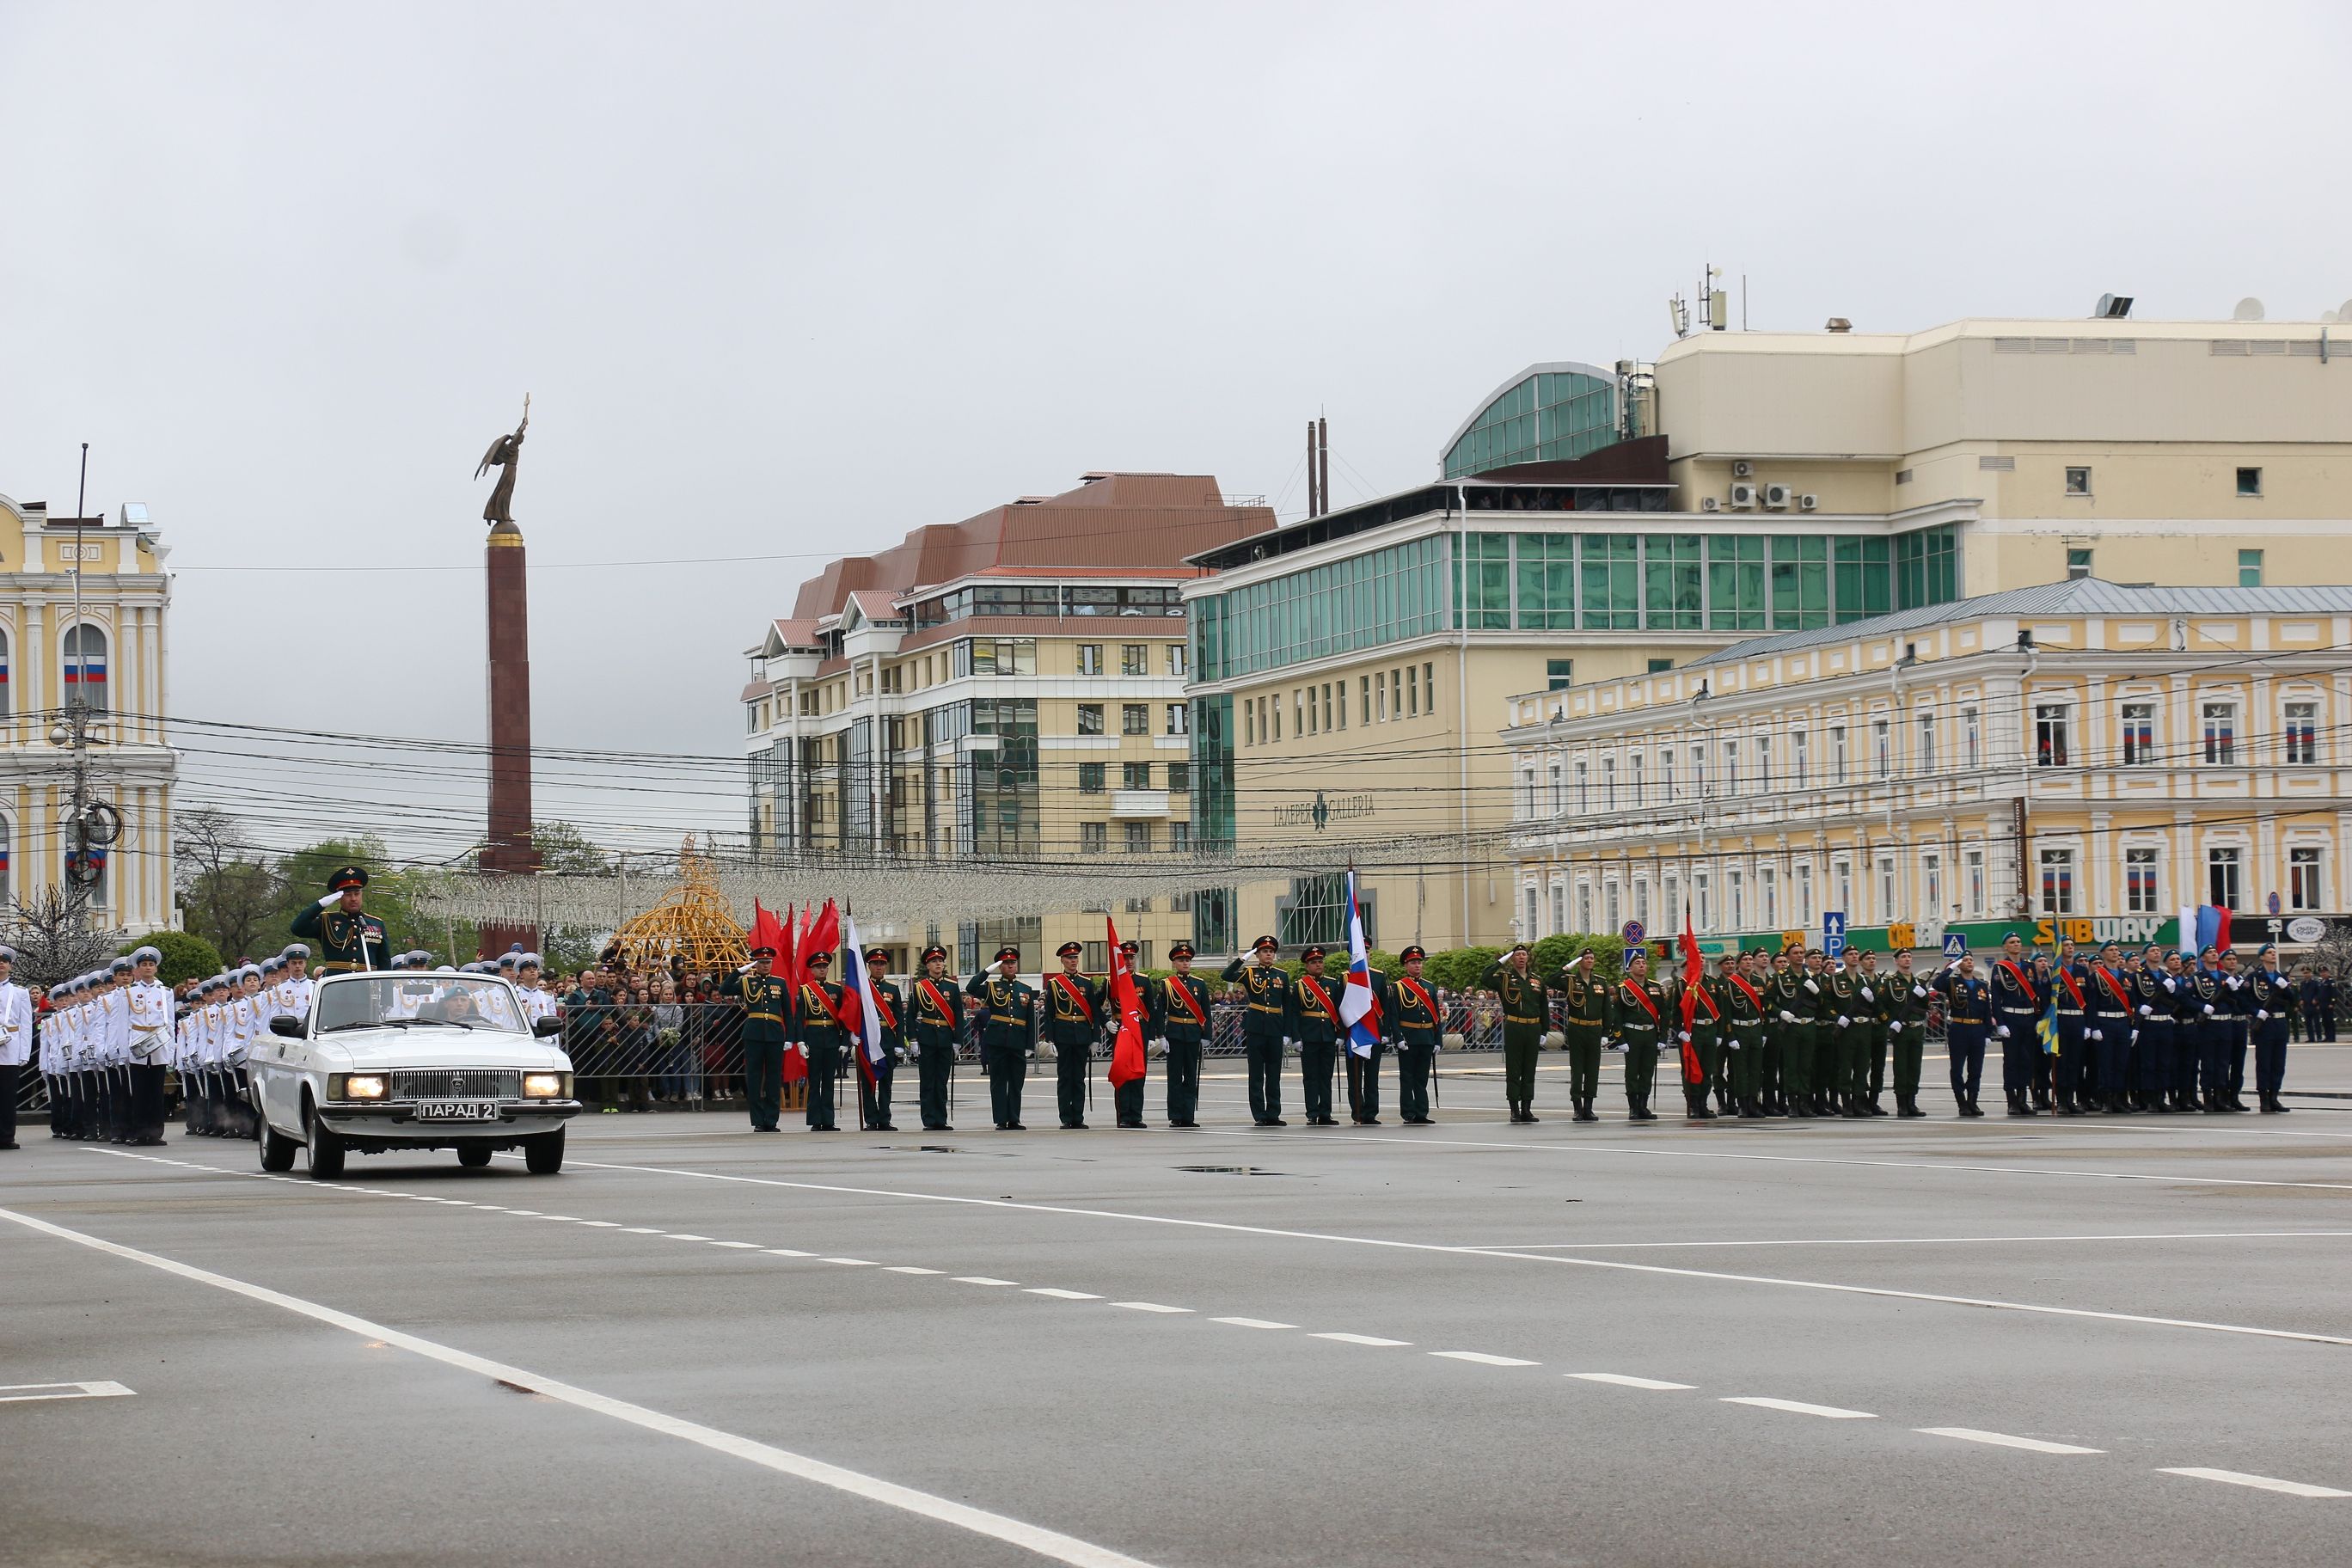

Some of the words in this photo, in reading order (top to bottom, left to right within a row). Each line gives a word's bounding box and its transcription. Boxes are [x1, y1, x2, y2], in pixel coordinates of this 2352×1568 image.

[1274, 803, 1311, 827] ГАЛЕРЕЯ
[1328, 793, 1375, 821] GALLERIA
[2032, 916, 2167, 945] SUBWAY
[1829, 938, 1841, 956] P
[422, 1104, 477, 1118] ПАРАД
[483, 1104, 493, 1118] 2
